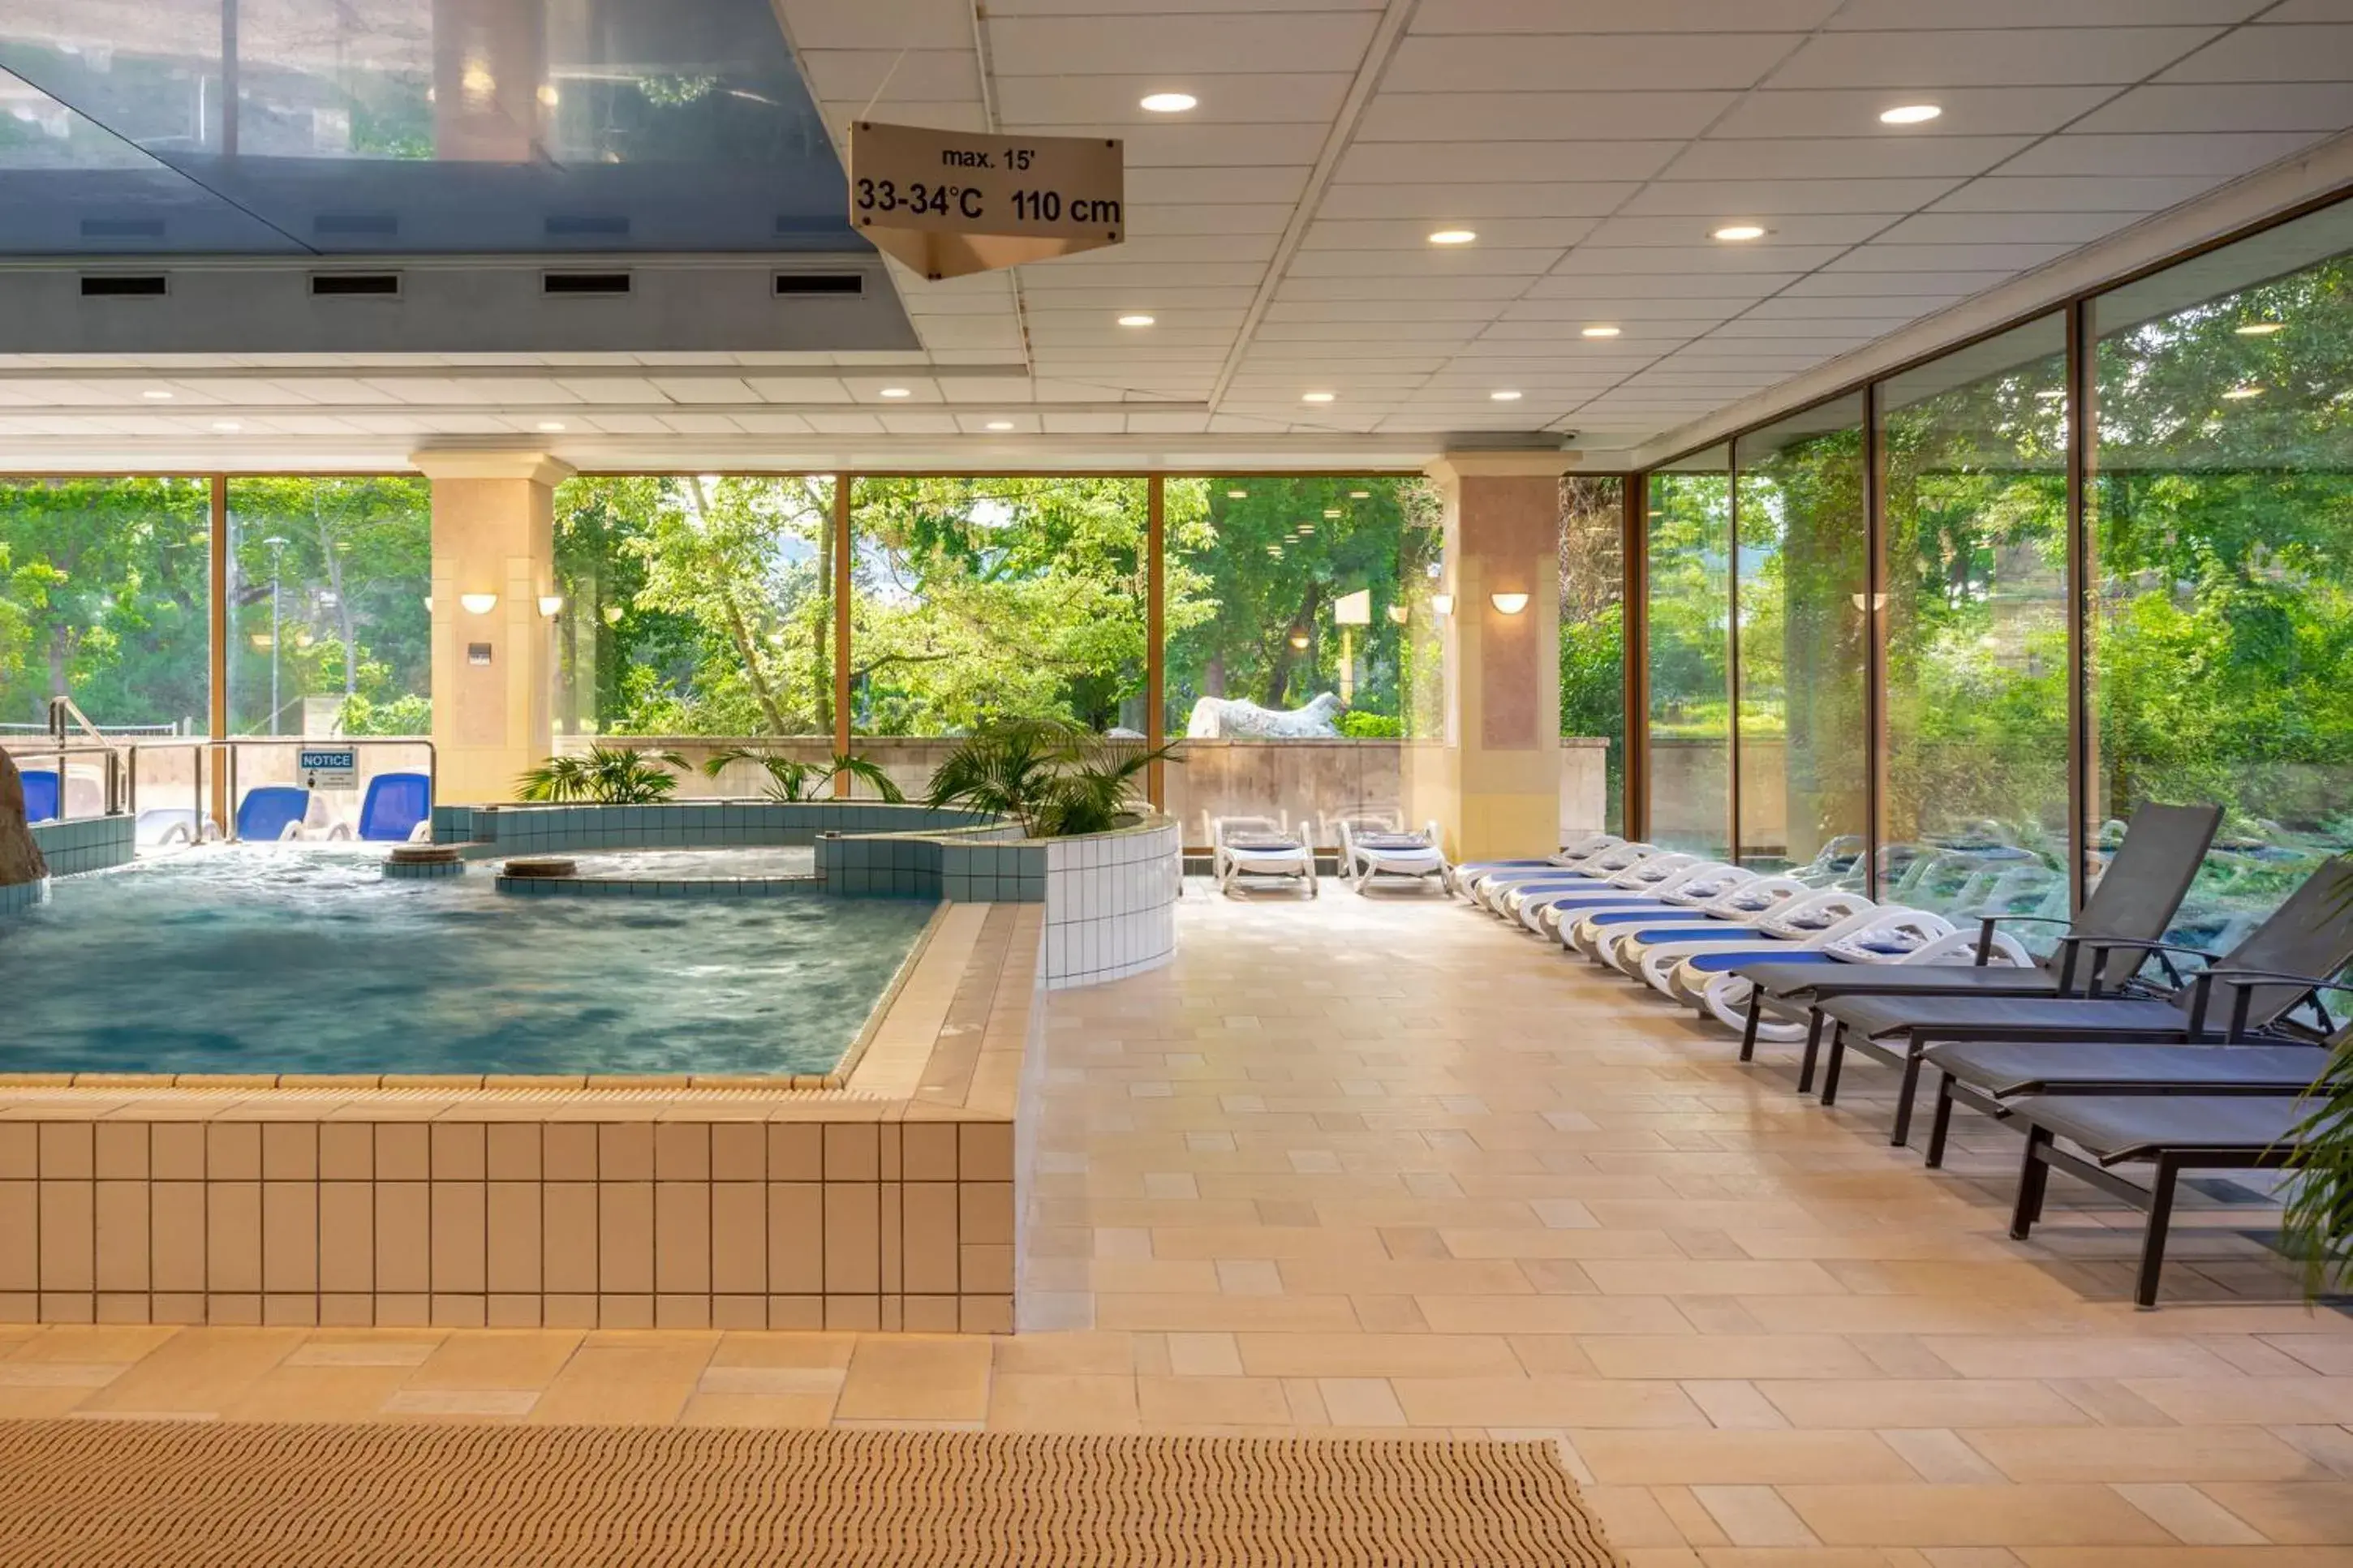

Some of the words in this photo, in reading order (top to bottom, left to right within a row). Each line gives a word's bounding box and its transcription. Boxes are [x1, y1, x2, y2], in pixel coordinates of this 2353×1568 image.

[942, 149, 996, 169] max.
[1004, 149, 1035, 170] 15'
[858, 178, 983, 218] 33-34°C
[1012, 191, 1060, 221] 110
[1070, 199, 1121, 223] cm
[303, 755, 351, 766] NOTICE
